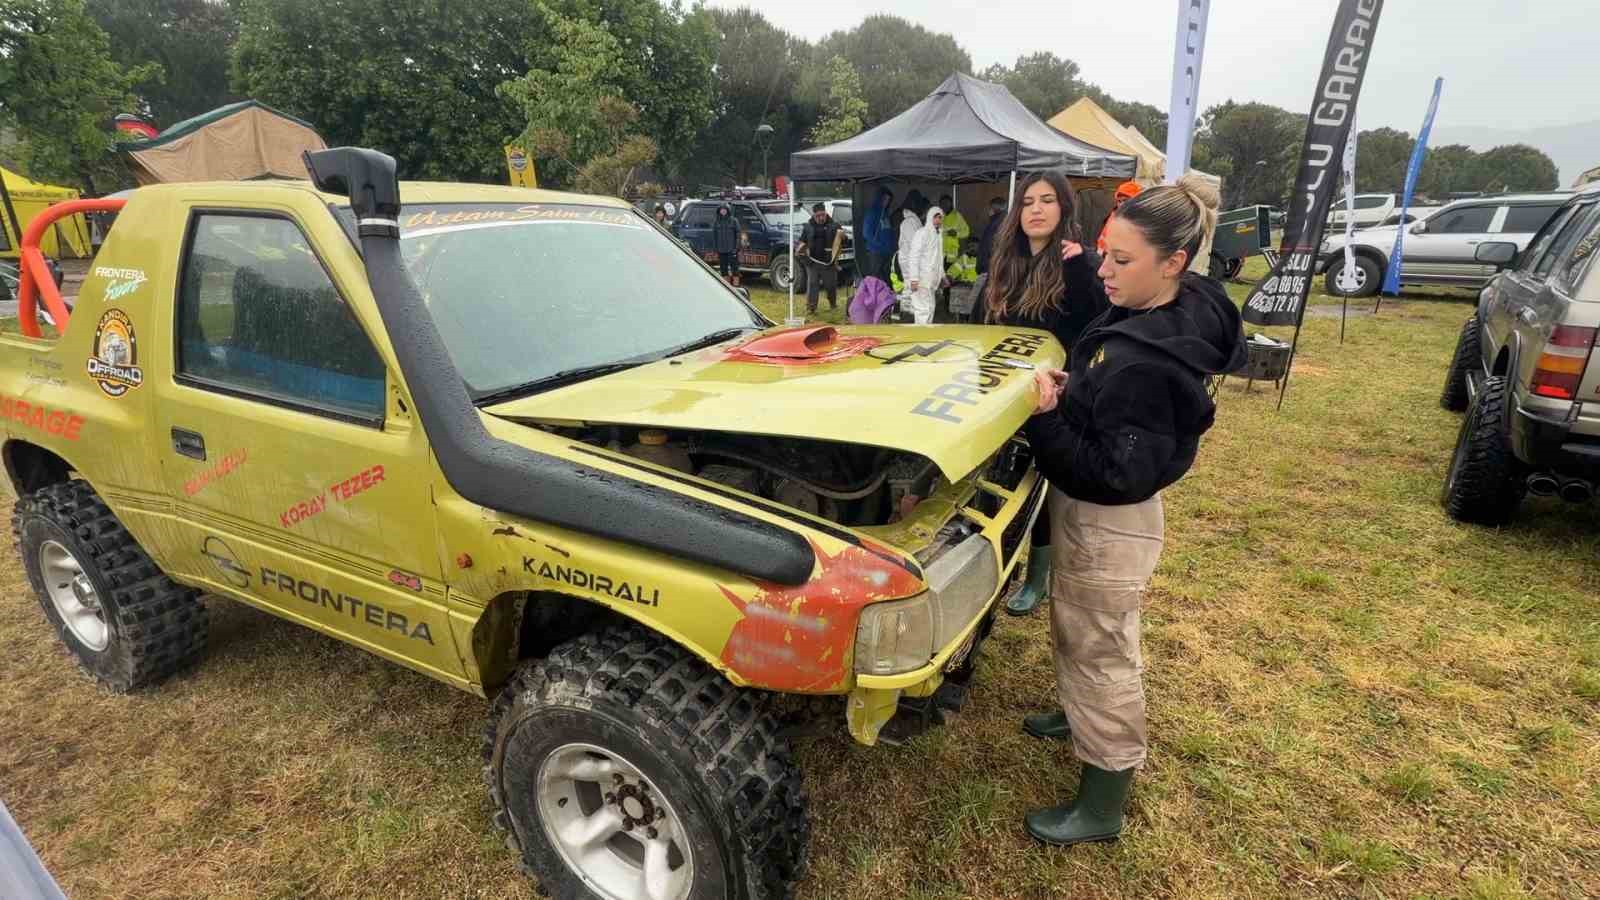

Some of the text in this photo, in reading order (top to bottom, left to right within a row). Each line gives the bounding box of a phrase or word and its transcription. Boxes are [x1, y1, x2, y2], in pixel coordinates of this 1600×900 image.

[95, 267, 147, 281] FRONTERA
[87, 358, 142, 384] OFFROAD
[909, 333, 1049, 424] FRONTERA
[279, 464, 386, 528] KORAY TEZER
[260, 567, 435, 646] FRONTERA
[522, 556, 660, 607] KANDIRALI
